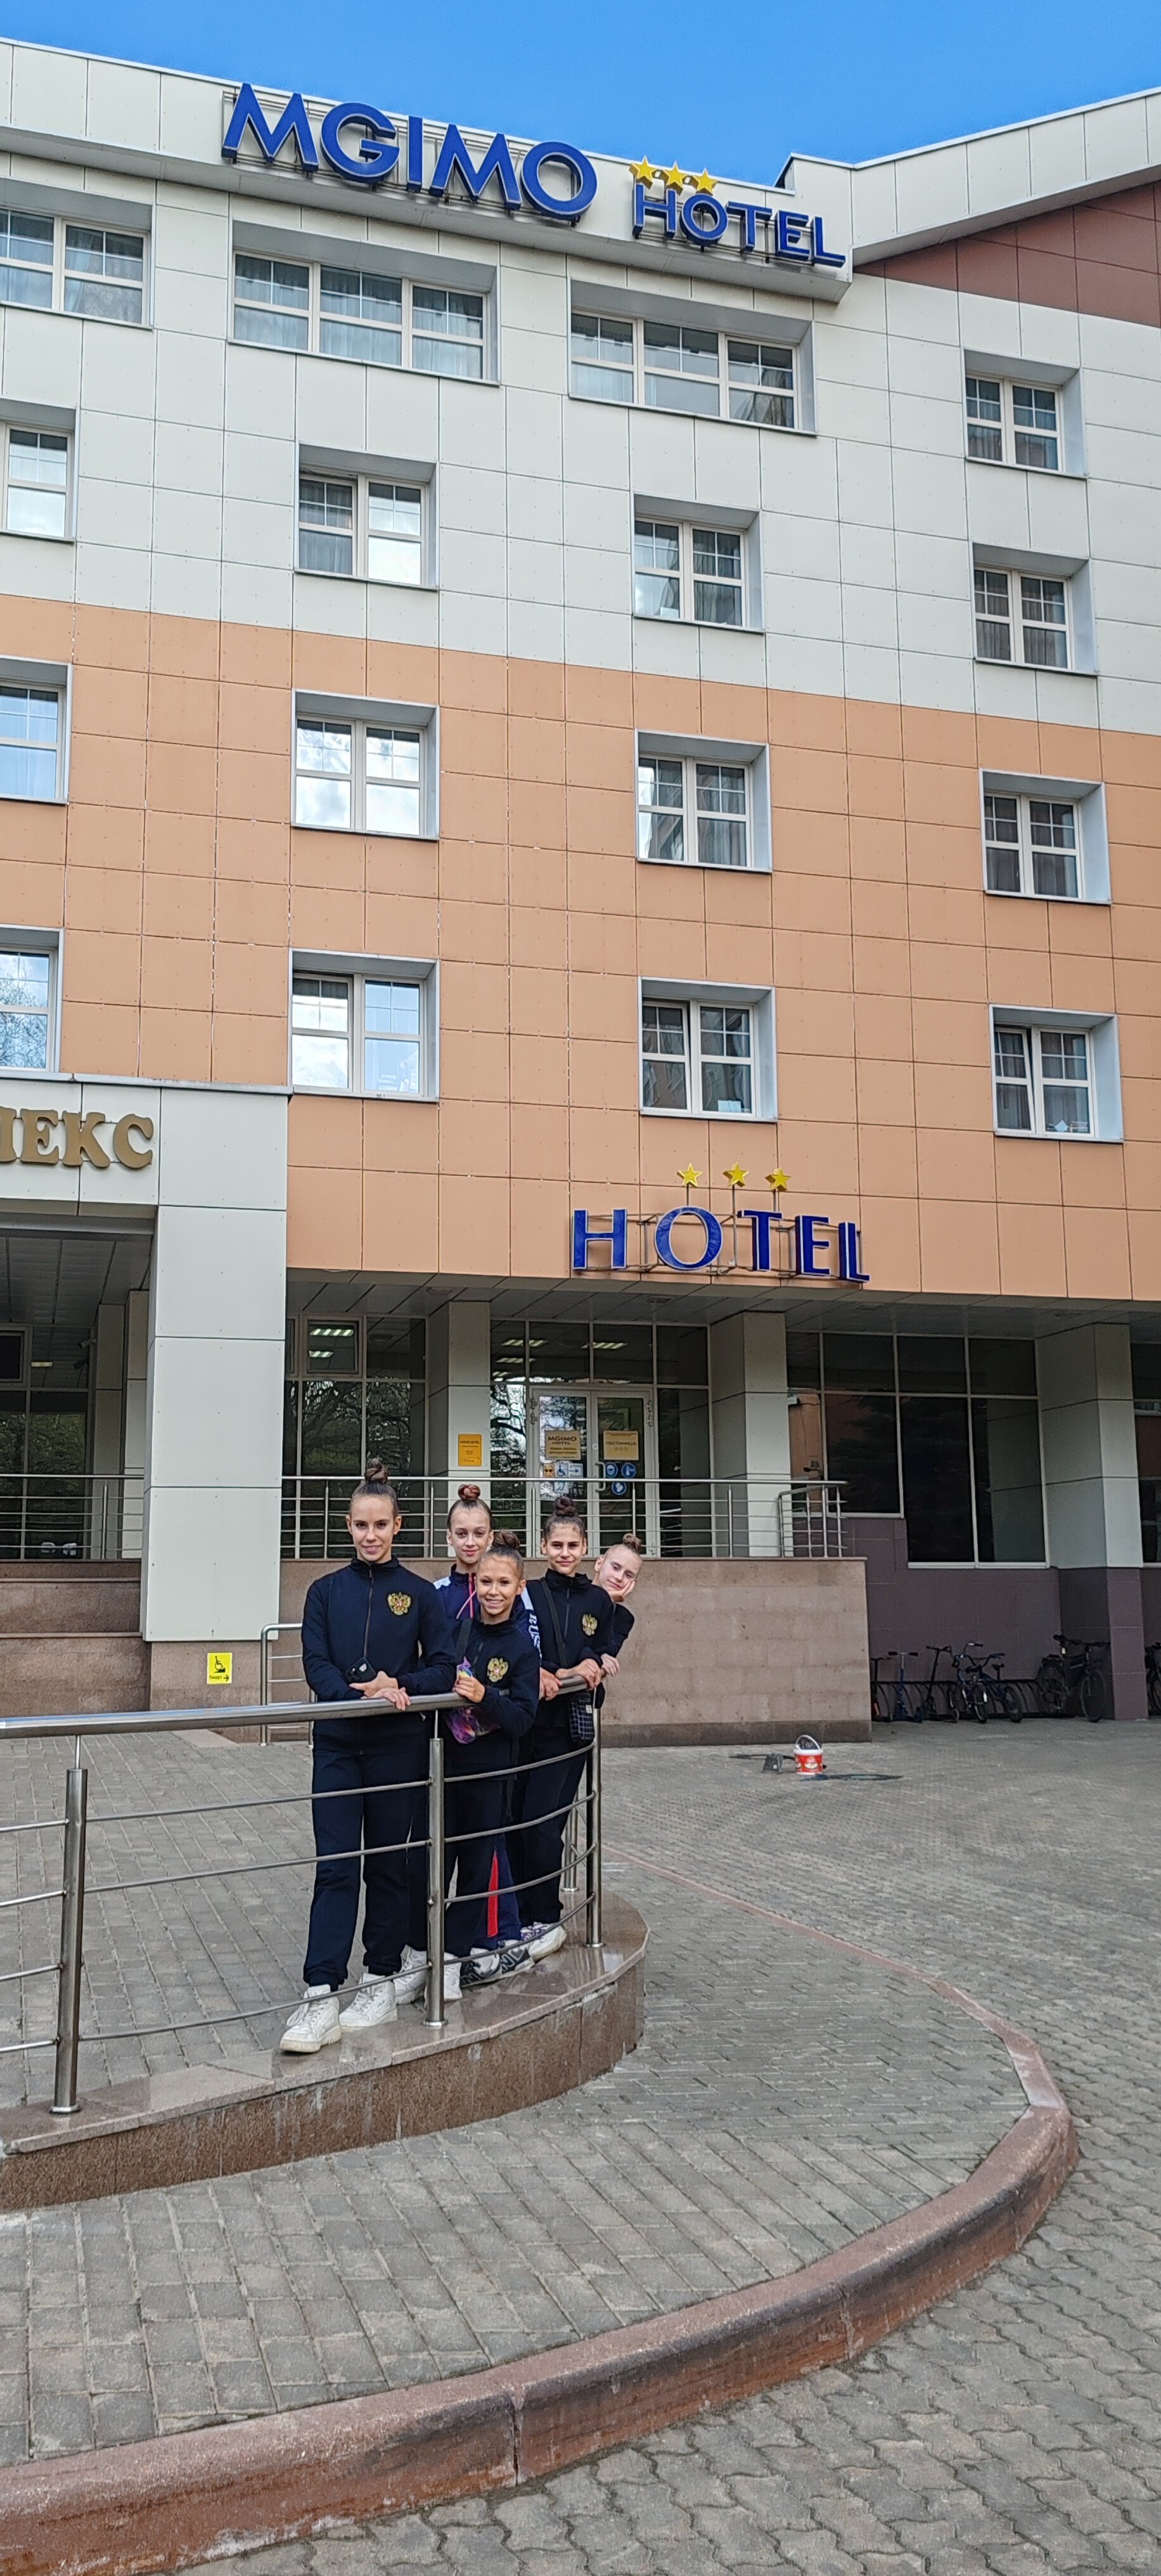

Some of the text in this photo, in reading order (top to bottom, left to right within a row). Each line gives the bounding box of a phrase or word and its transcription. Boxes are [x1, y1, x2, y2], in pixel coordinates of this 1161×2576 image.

[221, 82, 846, 267] MGIMO HOTEL
[572, 1206, 870, 1282] HOTEL
